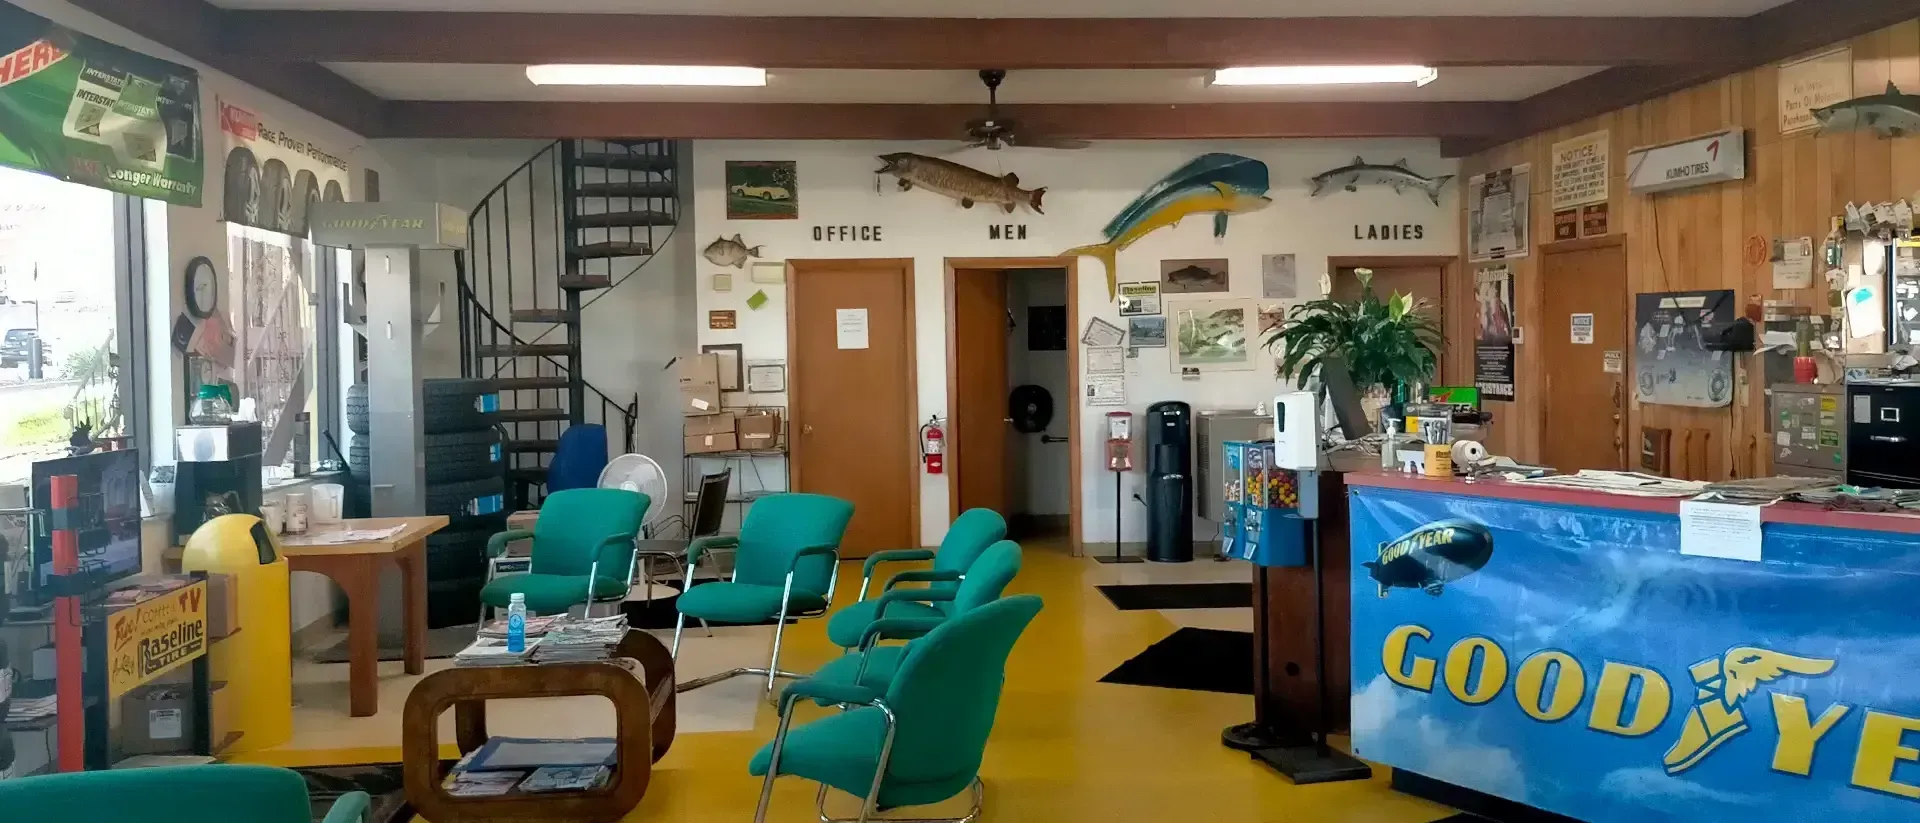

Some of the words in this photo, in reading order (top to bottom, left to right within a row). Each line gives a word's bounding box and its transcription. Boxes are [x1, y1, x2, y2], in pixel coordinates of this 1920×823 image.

[257, 122, 276, 144] Race
[278, 131, 304, 154] Proven
[1560, 143, 1598, 161] NOTICE!
[104, 164, 151, 187] Longer
[152, 172, 197, 196] Warranty
[1665, 165, 1691, 180] KUMHO
[1690, 161, 1710, 176] TIRES
[813, 225, 883, 242] OFFICE
[989, 224, 1027, 241] MEN
[1354, 224, 1424, 241] LADIES
[178, 587, 202, 613] TV
[137, 619, 204, 680] Baseline
